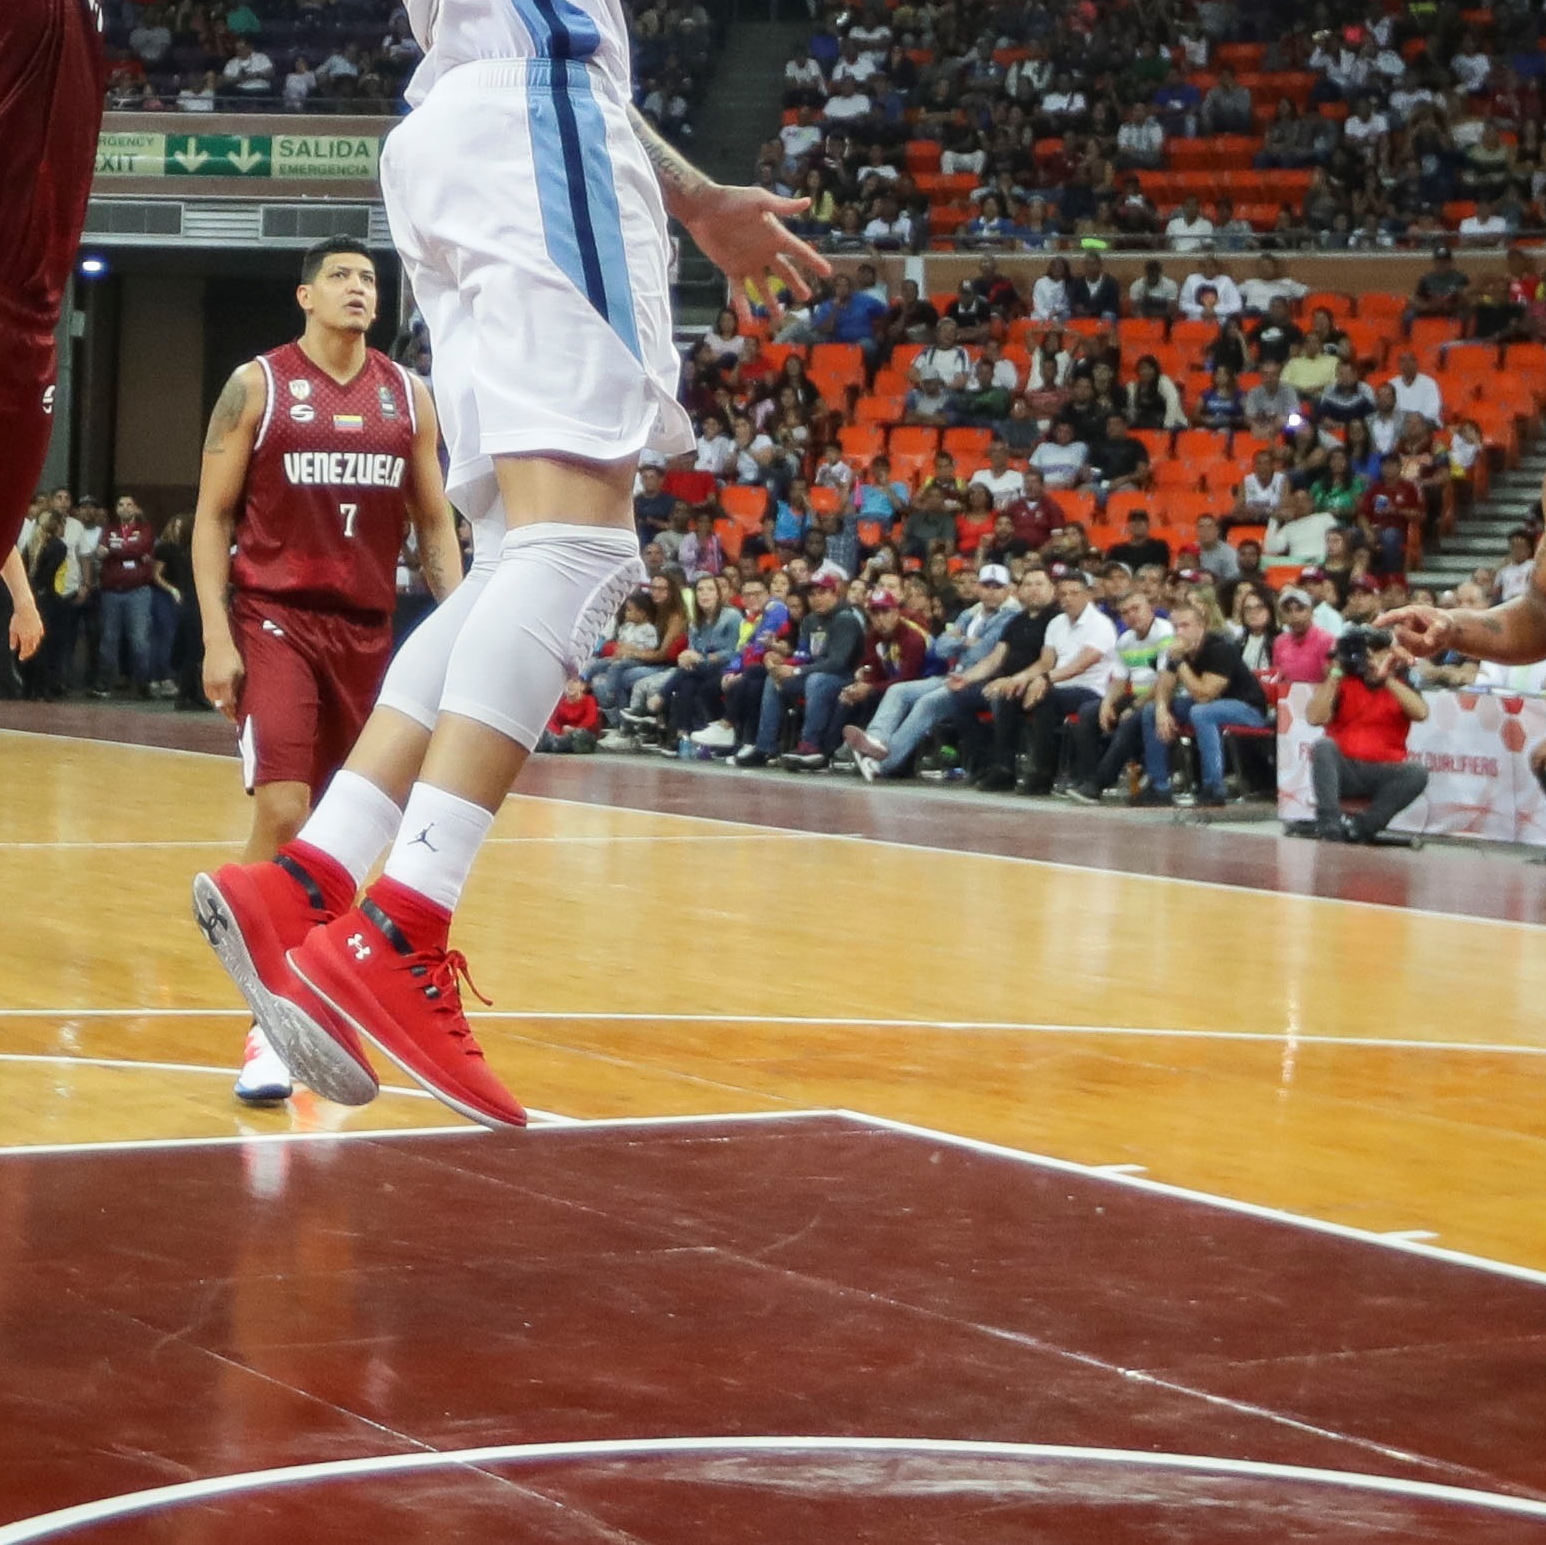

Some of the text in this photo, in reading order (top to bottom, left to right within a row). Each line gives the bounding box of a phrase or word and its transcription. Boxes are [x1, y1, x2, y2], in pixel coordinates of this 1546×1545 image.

[97, 137, 371, 173] XIT SALIDA
[278, 162, 372, 176] EMERGENCIA
[284, 451, 405, 489] VENEZUELA
[339, 502, 359, 539] 7
